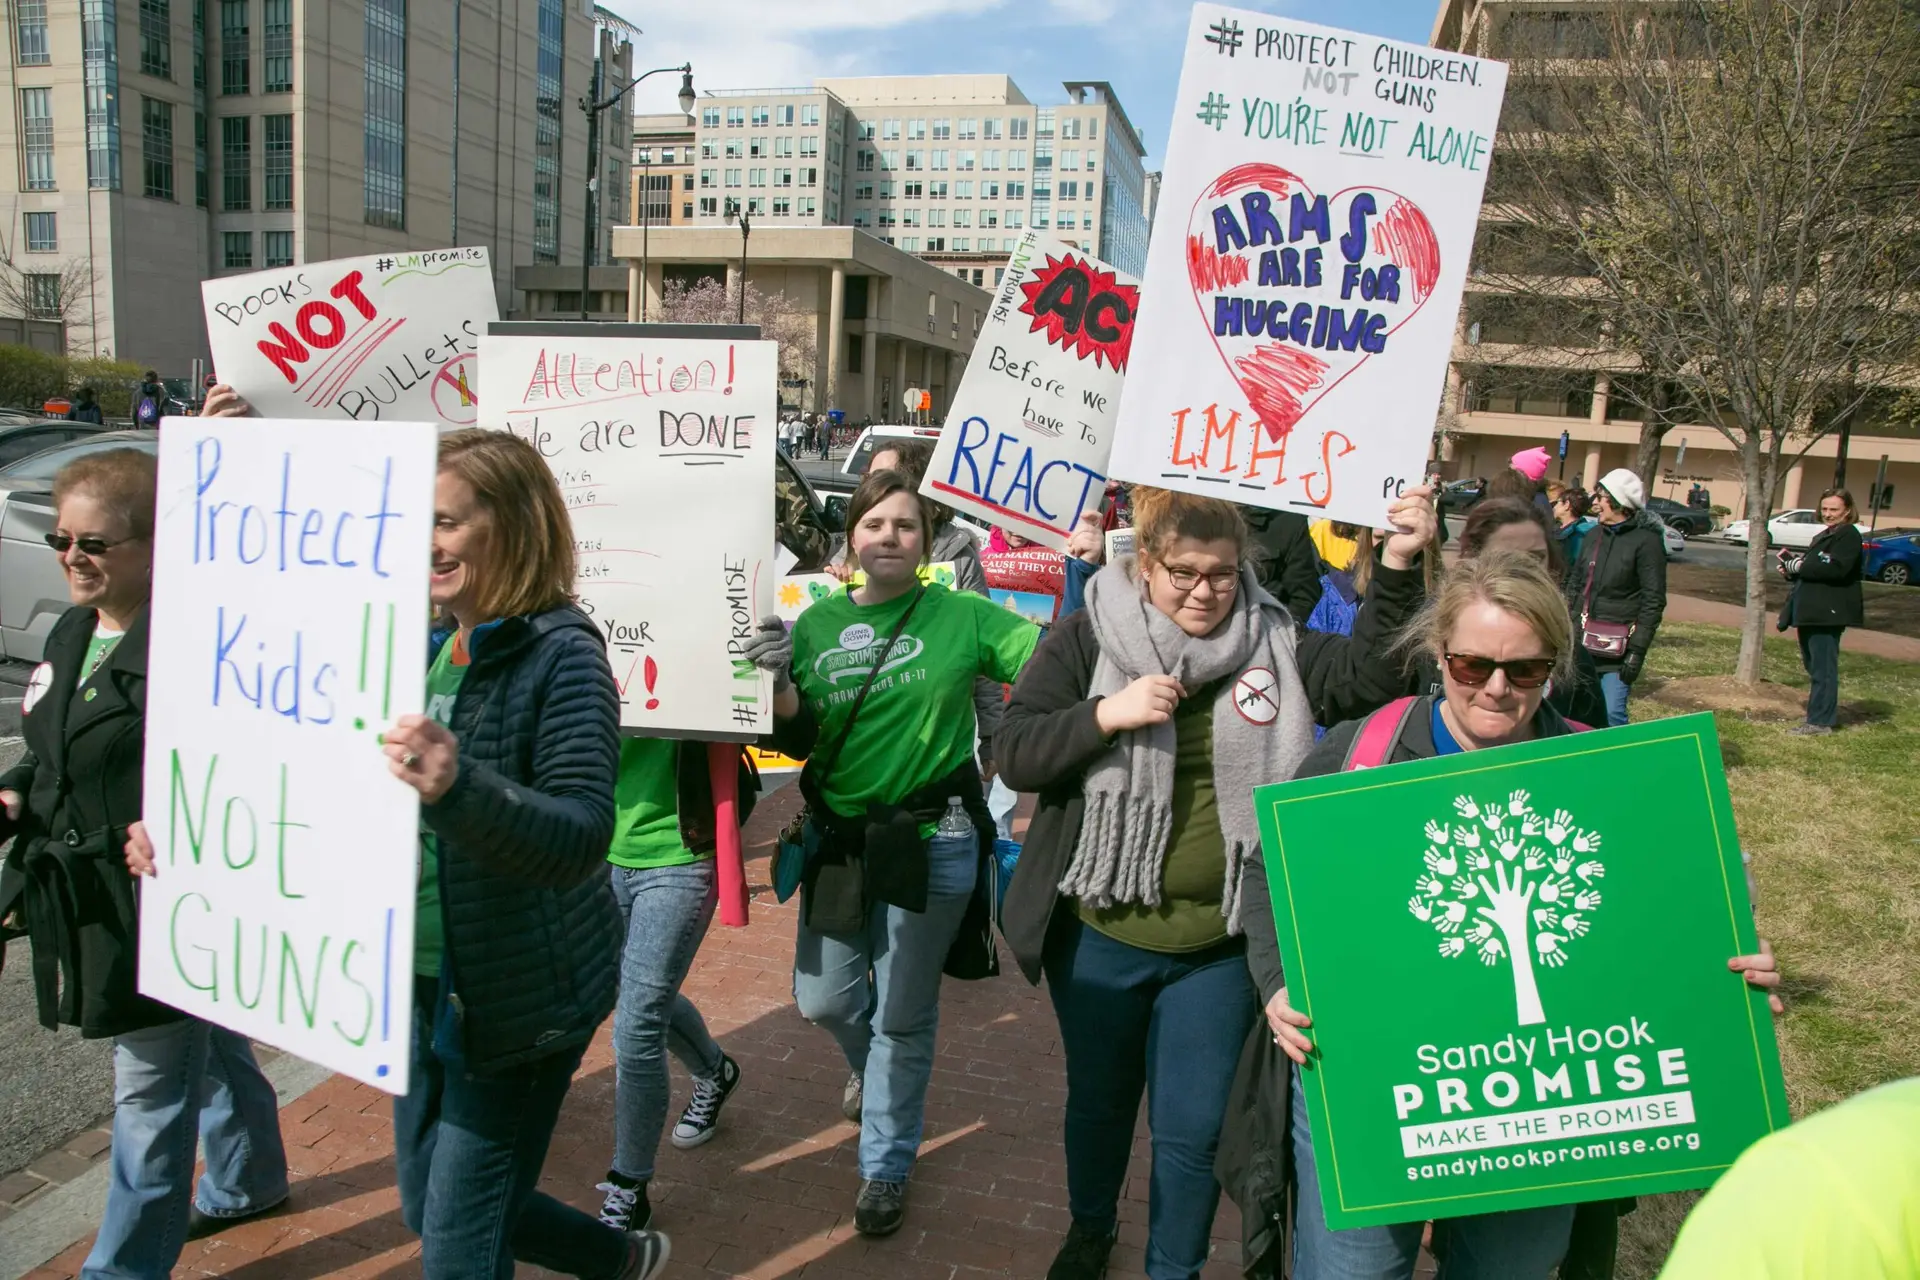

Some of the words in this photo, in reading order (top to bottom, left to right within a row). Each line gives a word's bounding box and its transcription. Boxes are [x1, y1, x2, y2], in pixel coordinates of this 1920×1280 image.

[1255, 27, 1357, 67] PROTECT
[1373, 43, 1482, 87] CHILDREN.
[1302, 66, 1359, 96] NOT
[1375, 79, 1437, 113] GUNS
[1242, 96, 1329, 146] YOU'RE
[1339, 111, 1399, 153] NOT
[1407, 121, 1488, 172] ALONE
[1212, 191, 1377, 263] ARMS
[214, 273, 312, 327] BOOKS
[992, 231, 1037, 327] #LMPROMISE
[1033, 266, 1137, 343] AC
[1258, 247, 1324, 289] ARE
[1340, 263, 1402, 304] FOR
[256, 270, 378, 385] NOT
[1213, 295, 1389, 355] HUGGING
[522, 344, 735, 404] Attention!
[988, 345, 1065, 398] Before
[506, 416, 564, 458] We
[579, 418, 638, 454] are
[658, 409, 756, 450] DONE
[1022, 397, 1065, 436] have
[947, 416, 1107, 532] REACT
[1171, 402, 1357, 507] LMHS
[193, 435, 405, 579] Protect
[1003, 551, 1066, 563] MARCHING
[1017, 561, 1047, 573] THEY
[1048, 565, 1066, 576] CA
[604, 619, 655, 644] YOUR
[843, 632, 870, 643] DOWN
[844, 627, 869, 637] GUNS
[900, 668, 926, 685] 16-17
[169, 748, 311, 899] Not
[170, 891, 394, 1078] GUNS!
[1415, 1032, 1537, 1075] Sandy
[1546, 1015, 1656, 1058] Hook
[1392, 1047, 1691, 1121] PROMISE
[1416, 1124, 1488, 1150] MAKE
[1498, 1116, 1549, 1139] THE
[1559, 1100, 1679, 1132] PROMISE
[1406, 1132, 1701, 1181] sandyhookpromise.org
